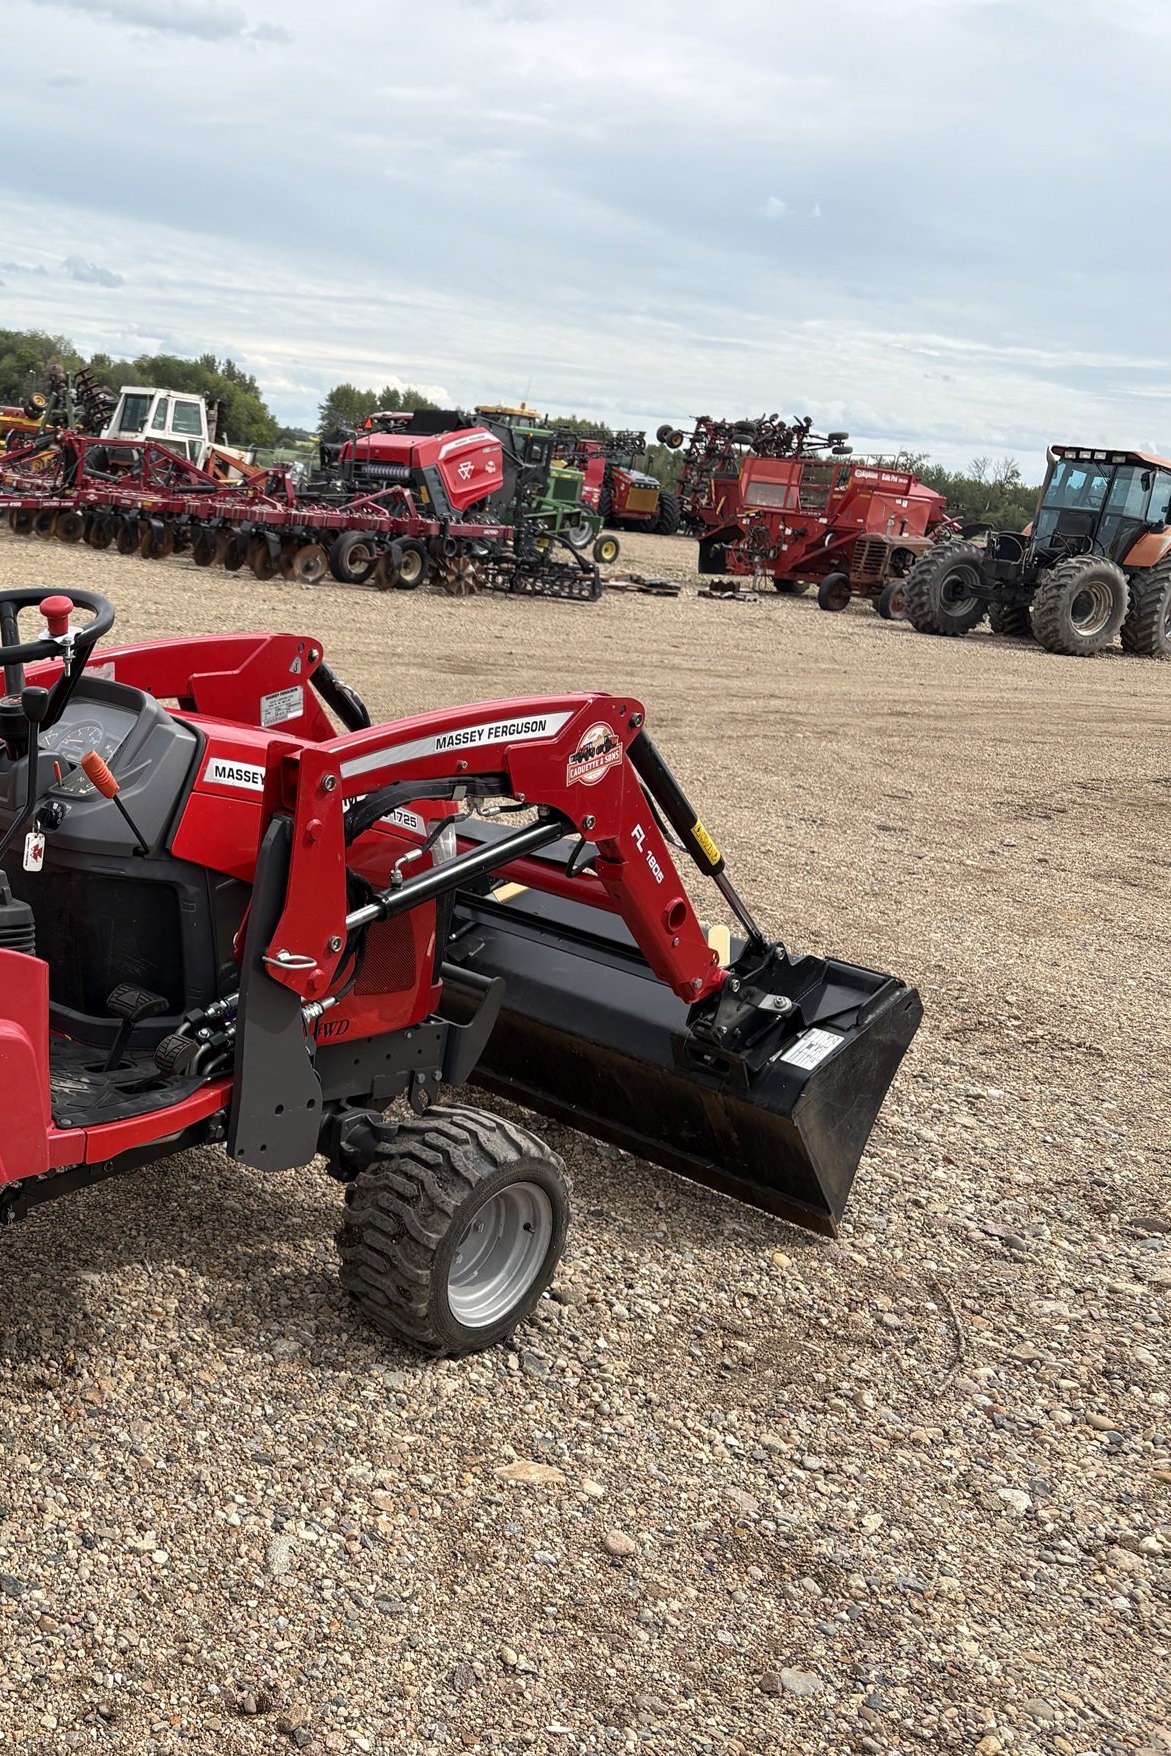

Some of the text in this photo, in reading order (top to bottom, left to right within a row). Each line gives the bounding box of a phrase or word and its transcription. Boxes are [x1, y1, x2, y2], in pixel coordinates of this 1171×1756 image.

[435, 719, 547, 750] MASSEY FERGUSON
[570, 759, 599, 778] CAOUETTE
[599, 757, 604, 766] &
[604, 750, 620, 764] SONS
[631, 823, 665, 884] FL 1805
